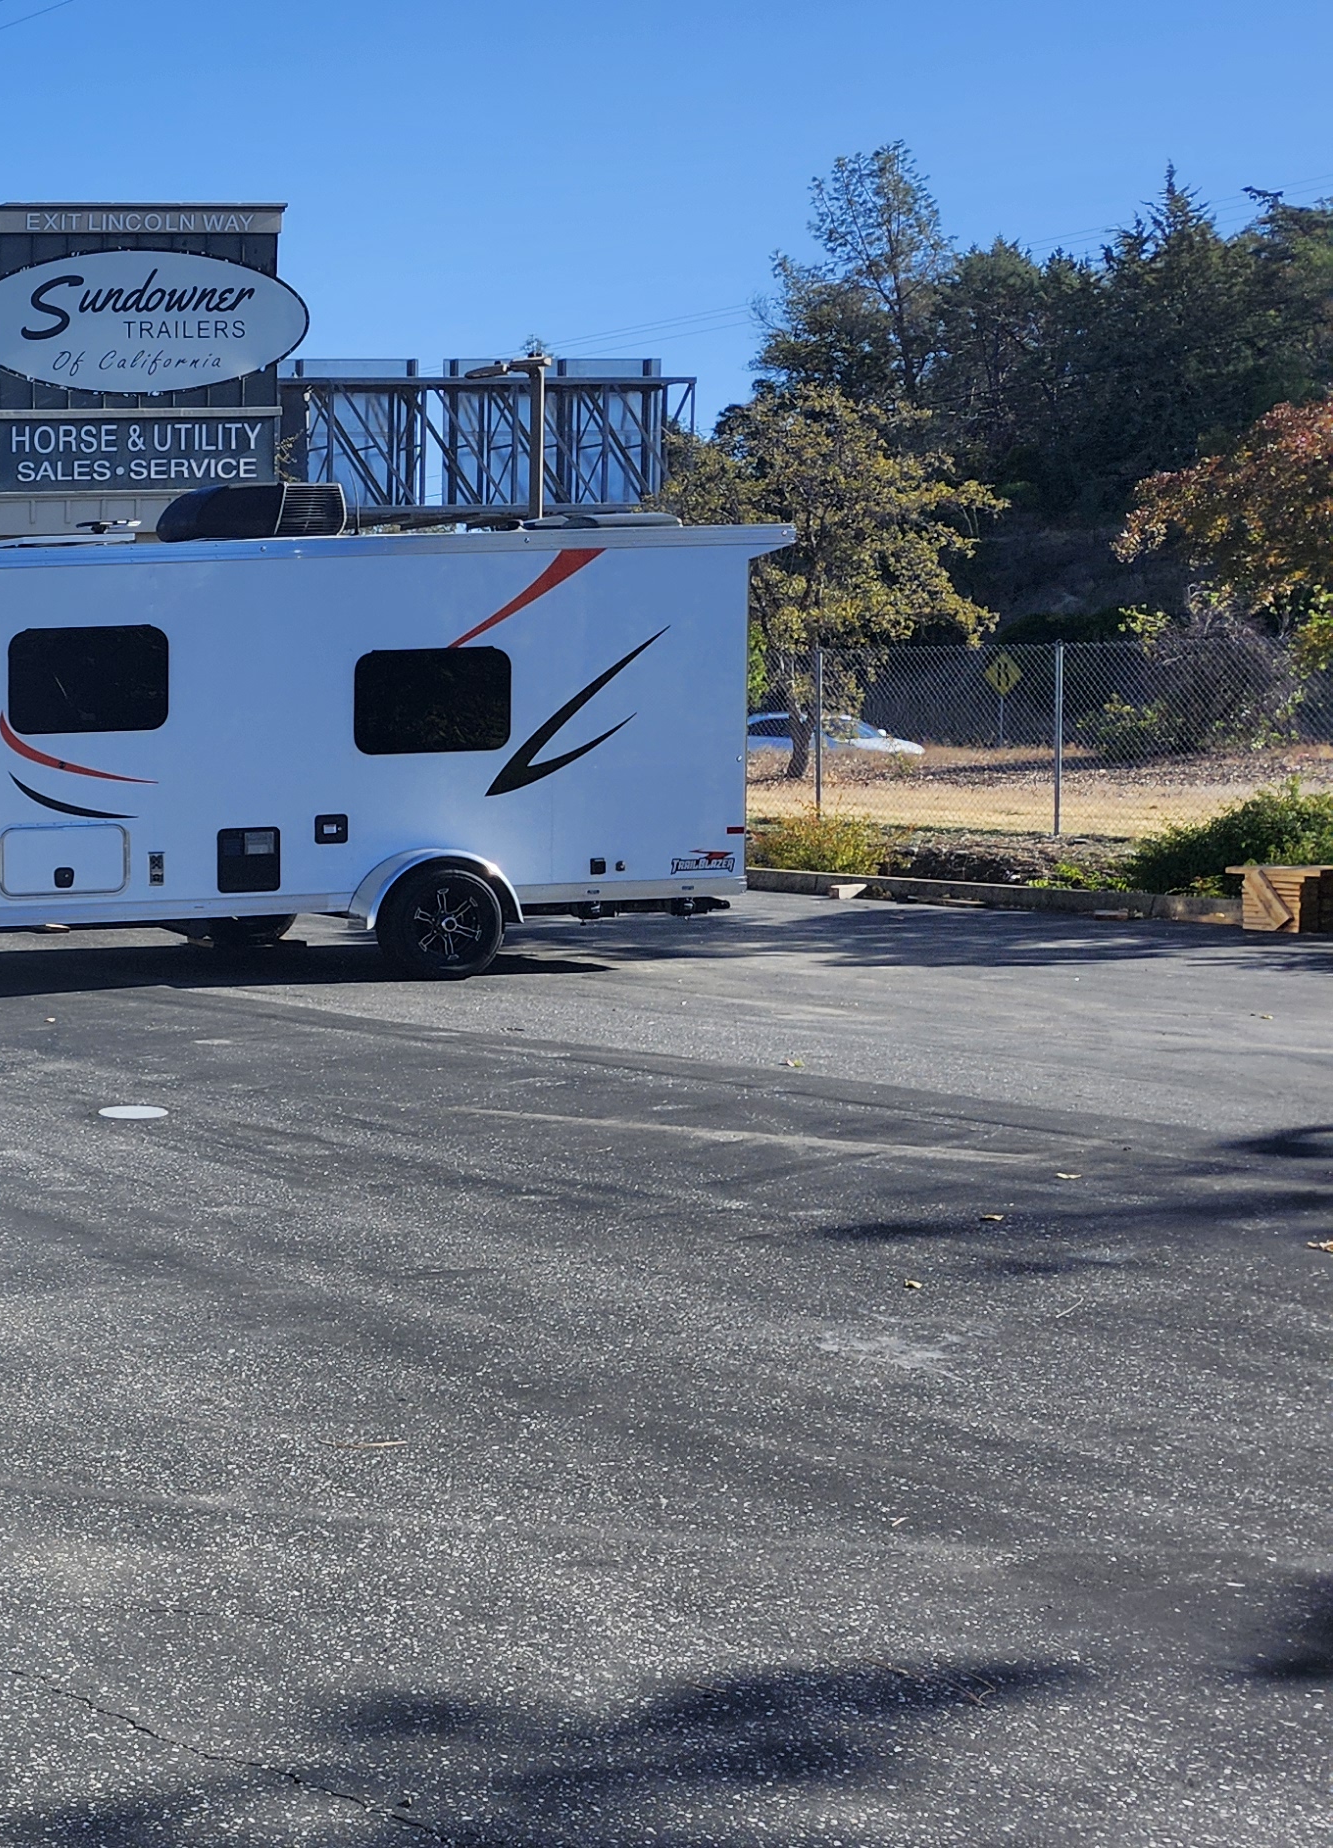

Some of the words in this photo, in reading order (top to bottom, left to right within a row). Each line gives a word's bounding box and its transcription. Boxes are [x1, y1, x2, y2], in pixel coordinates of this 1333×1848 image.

[25, 212, 83, 231] EXIT
[87, 212, 197, 232] LINCOLN
[201, 213, 255, 232] WAY
[20, 268, 255, 341] Sundowner
[123, 320, 246, 339] TRAILERS
[52, 349, 84, 376] Of
[99, 349, 222, 376] California
[10, 424, 119, 454] HORSE
[127, 424, 146, 452] &
[153, 422, 263, 452] UTILITY
[16, 461, 111, 482] SALES
[129, 457, 258, 480] SERVICE
